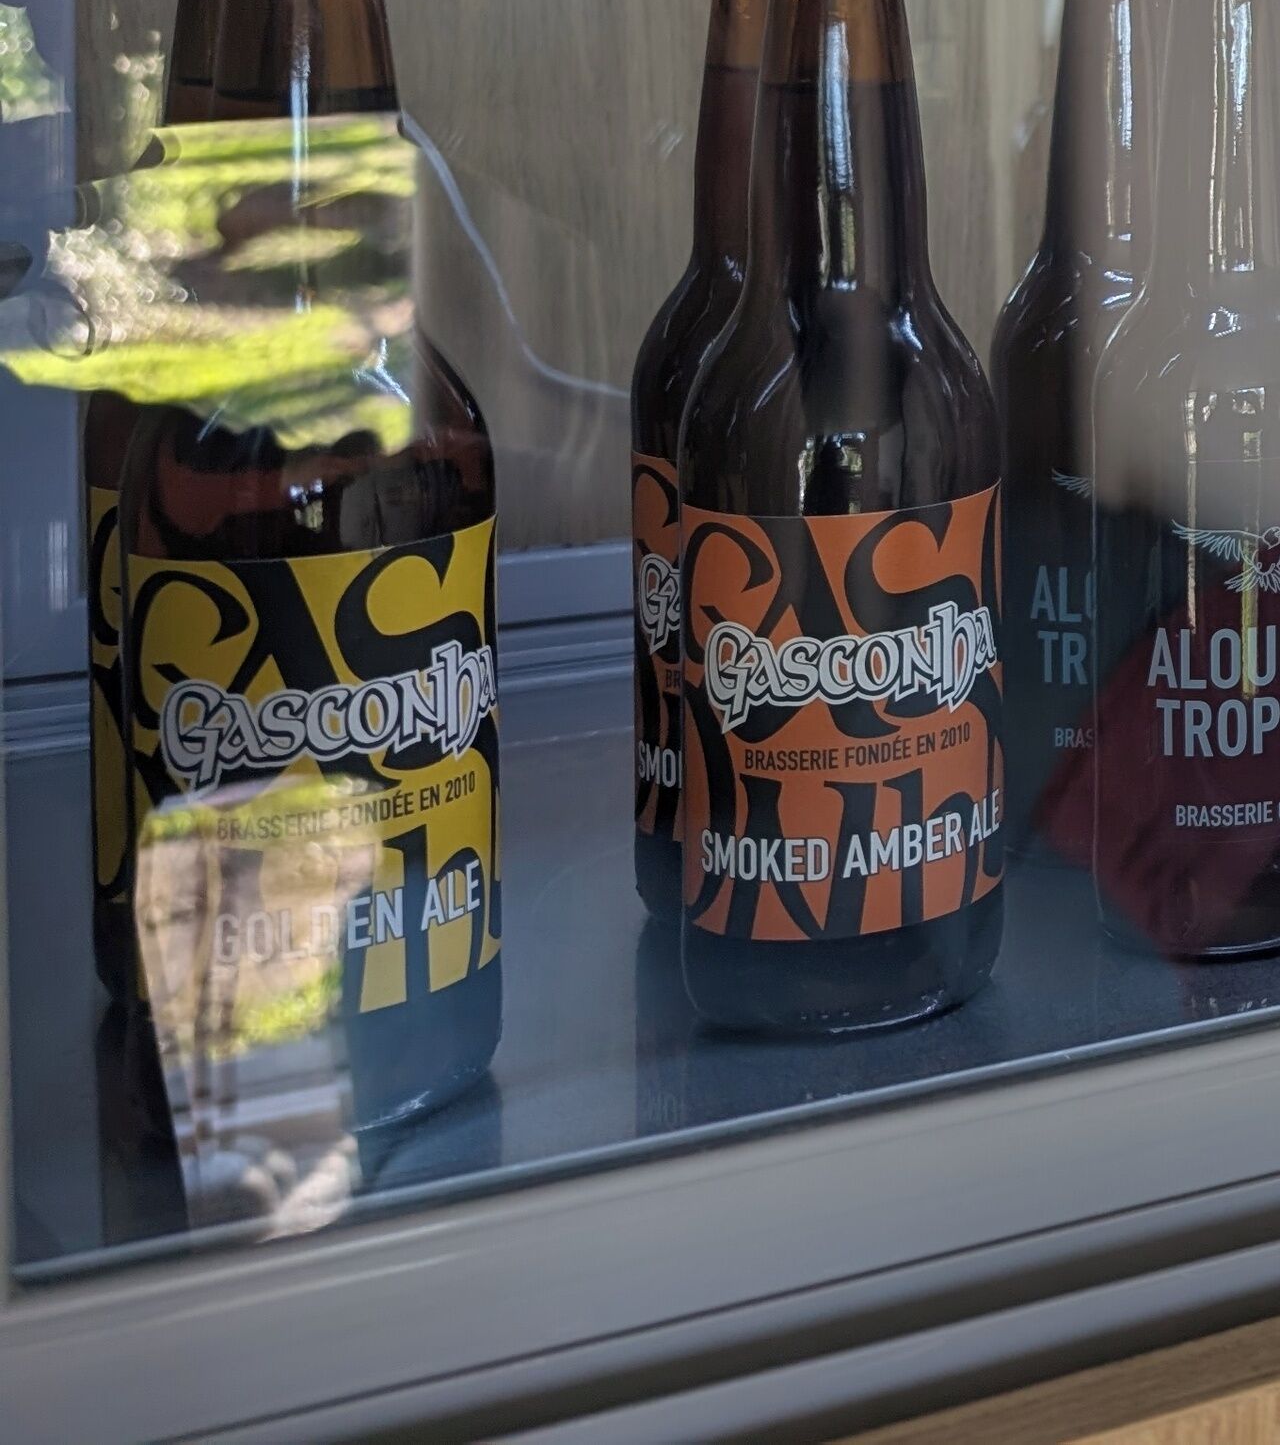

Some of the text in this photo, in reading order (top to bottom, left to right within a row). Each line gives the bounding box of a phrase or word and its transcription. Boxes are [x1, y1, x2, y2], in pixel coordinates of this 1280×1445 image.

[744, 722, 970, 771] BRASSERIE FONDÉE EN 2010
[339, 791, 413, 829] FONDÉE
[419, 781, 440, 811] EN
[445, 771, 475, 802] 2010
[1176, 801, 1273, 826] BRASSERIE
[701, 787, 1000, 882] SMOKED AMBER ALE
[215, 859, 480, 963] GOLDEN ALE
